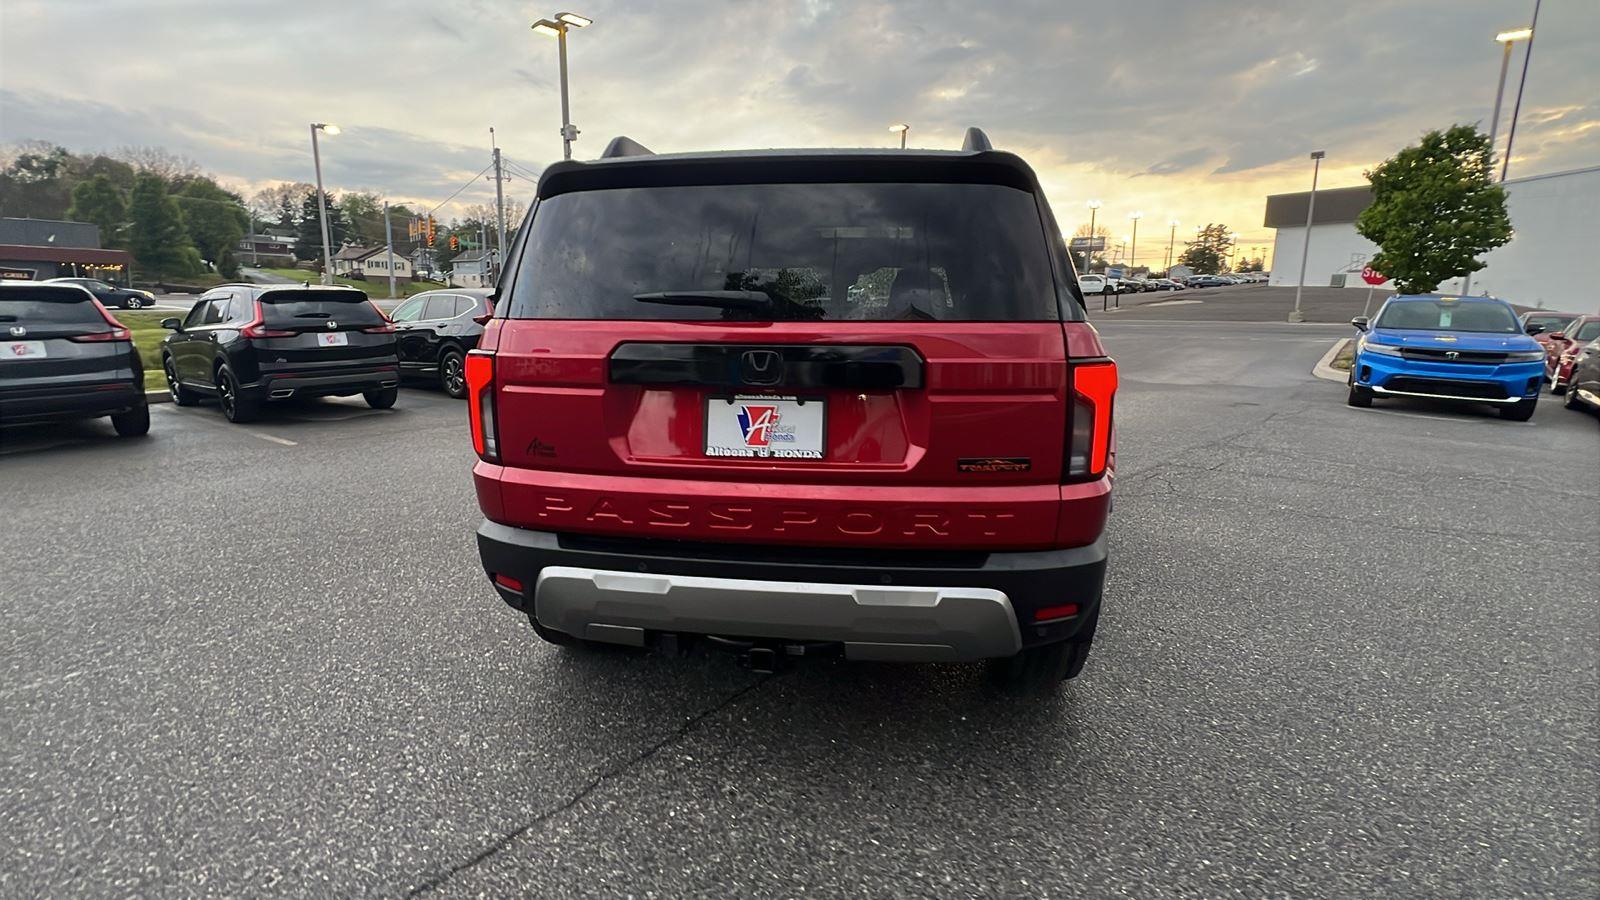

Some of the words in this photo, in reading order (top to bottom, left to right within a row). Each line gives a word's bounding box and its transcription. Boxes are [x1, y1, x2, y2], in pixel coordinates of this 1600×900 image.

[706, 447, 754, 457] Altoona
[773, 450, 823, 459] HONDA
[538, 497, 1014, 536] PASSPORT
